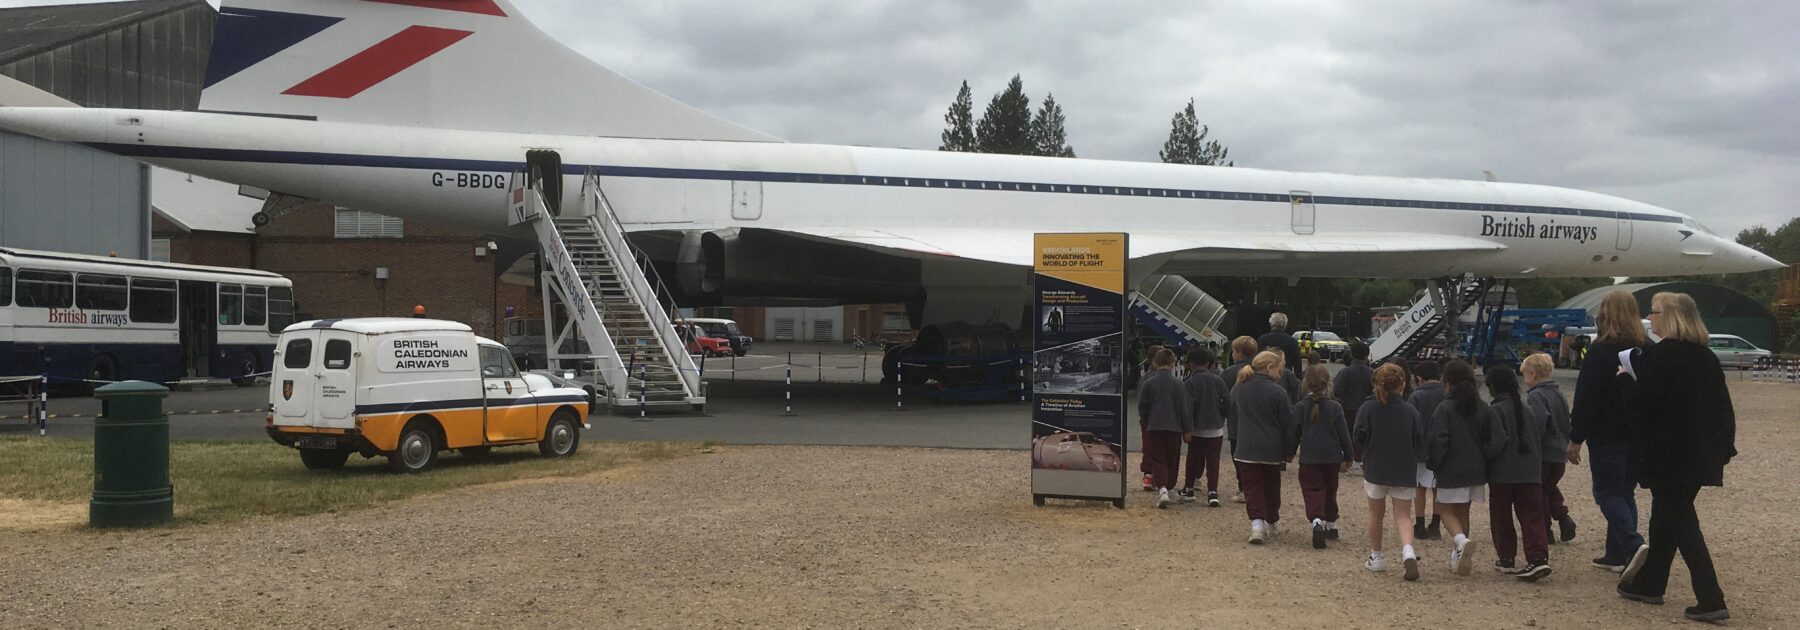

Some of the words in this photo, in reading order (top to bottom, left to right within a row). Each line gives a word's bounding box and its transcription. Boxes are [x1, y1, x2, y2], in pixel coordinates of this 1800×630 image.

[432, 172, 505, 189] G-BBDG
[1480, 215, 1535, 238] British
[1539, 219, 1598, 244] airways
[558, 252, 586, 321] Concorde
[48, 308, 87, 324] British
[91, 311, 128, 327] airways
[1411, 301, 1436, 324] Conc
[393, 340, 439, 348] BRITISH
[394, 349, 468, 358] CALEDONIAN
[395, 360, 450, 368] AIRWAYS
